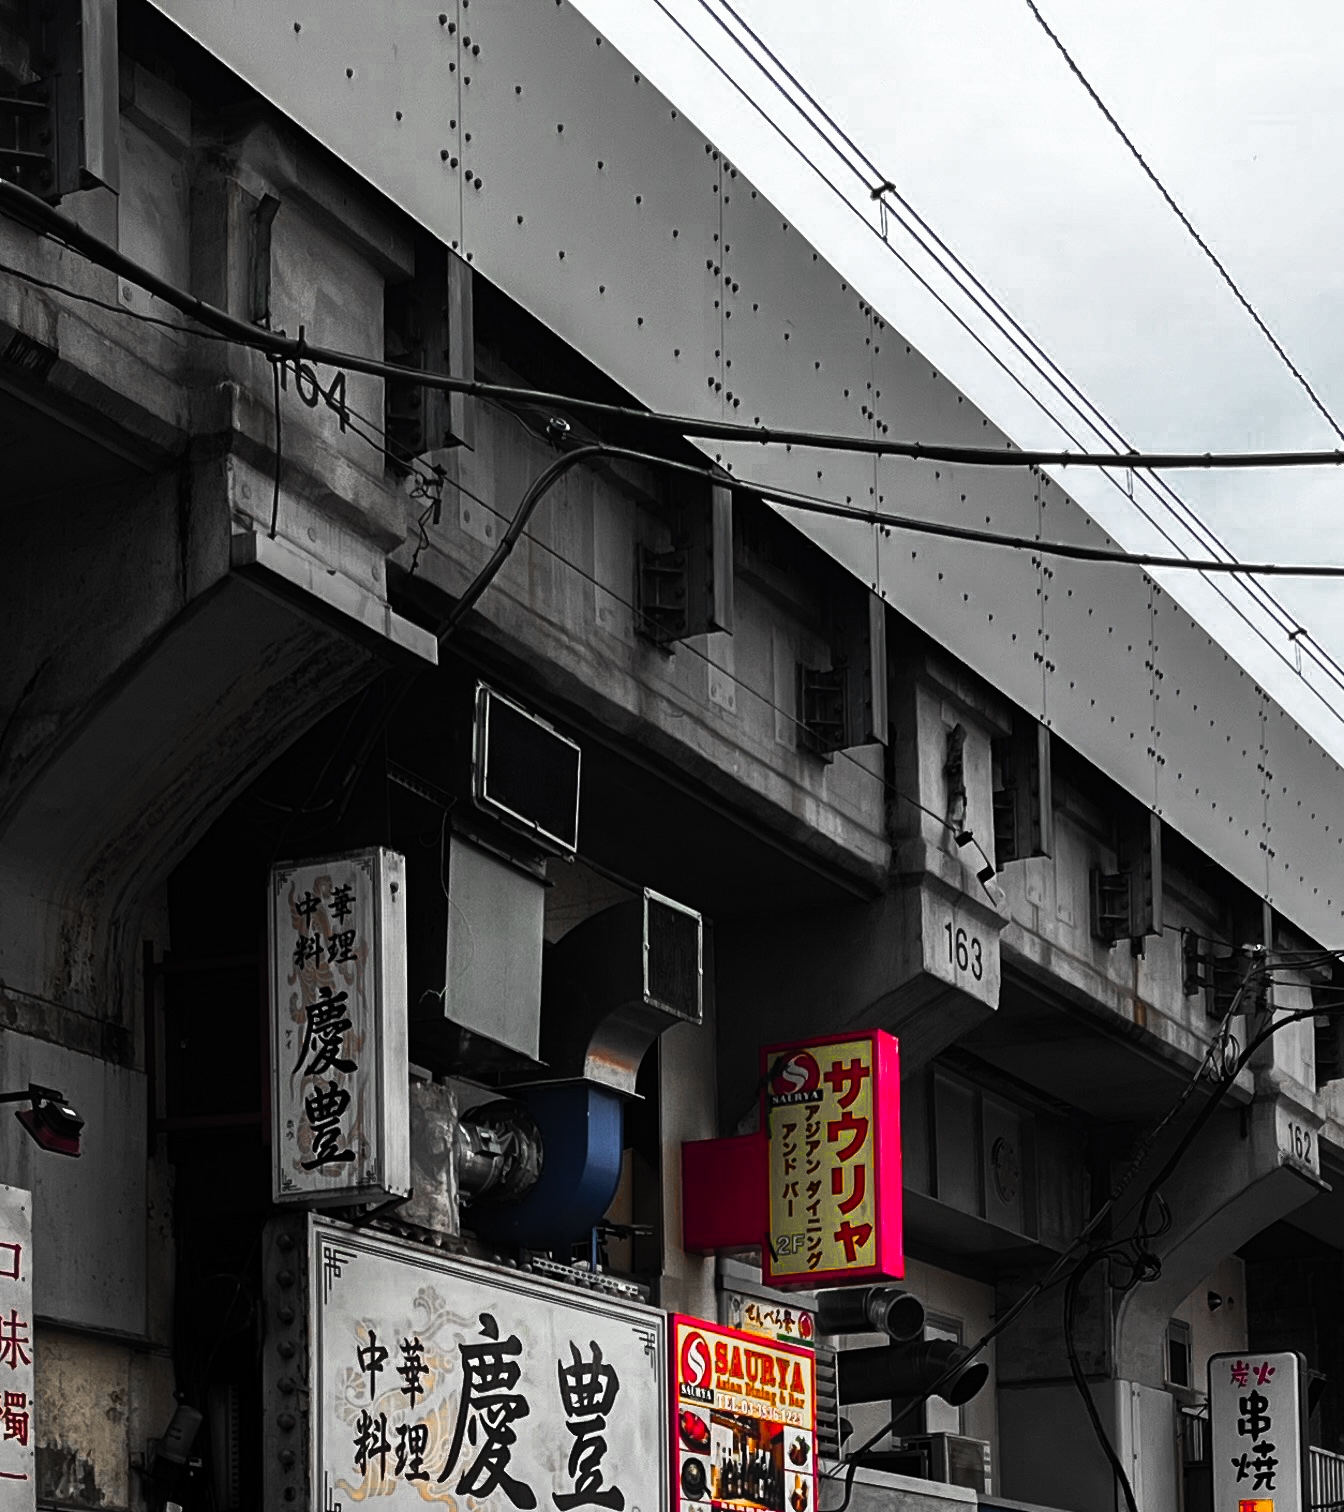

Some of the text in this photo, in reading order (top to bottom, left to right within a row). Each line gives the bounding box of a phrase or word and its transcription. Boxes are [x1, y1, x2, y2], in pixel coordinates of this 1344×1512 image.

[279, 358, 350, 433] 164
[293, 884, 357, 929] 中華
[293, 929, 358, 970] 料理
[944, 922, 984, 982] 163
[781, 1122, 800, 1218] アンド バー
[1288, 1121, 1312, 1164] 162
[804, 1103, 824, 1271] アジアン ダイニング
[776, 1233, 806, 1256] 2F
[355, 1335, 430, 1411] 中華
[714, 1340, 806, 1396] SAURYA
[1230, 1360, 1276, 1387] 炭火
[353, 1409, 431, 1483] 料理
[1232, 1390, 1278, 1492] 串焼
